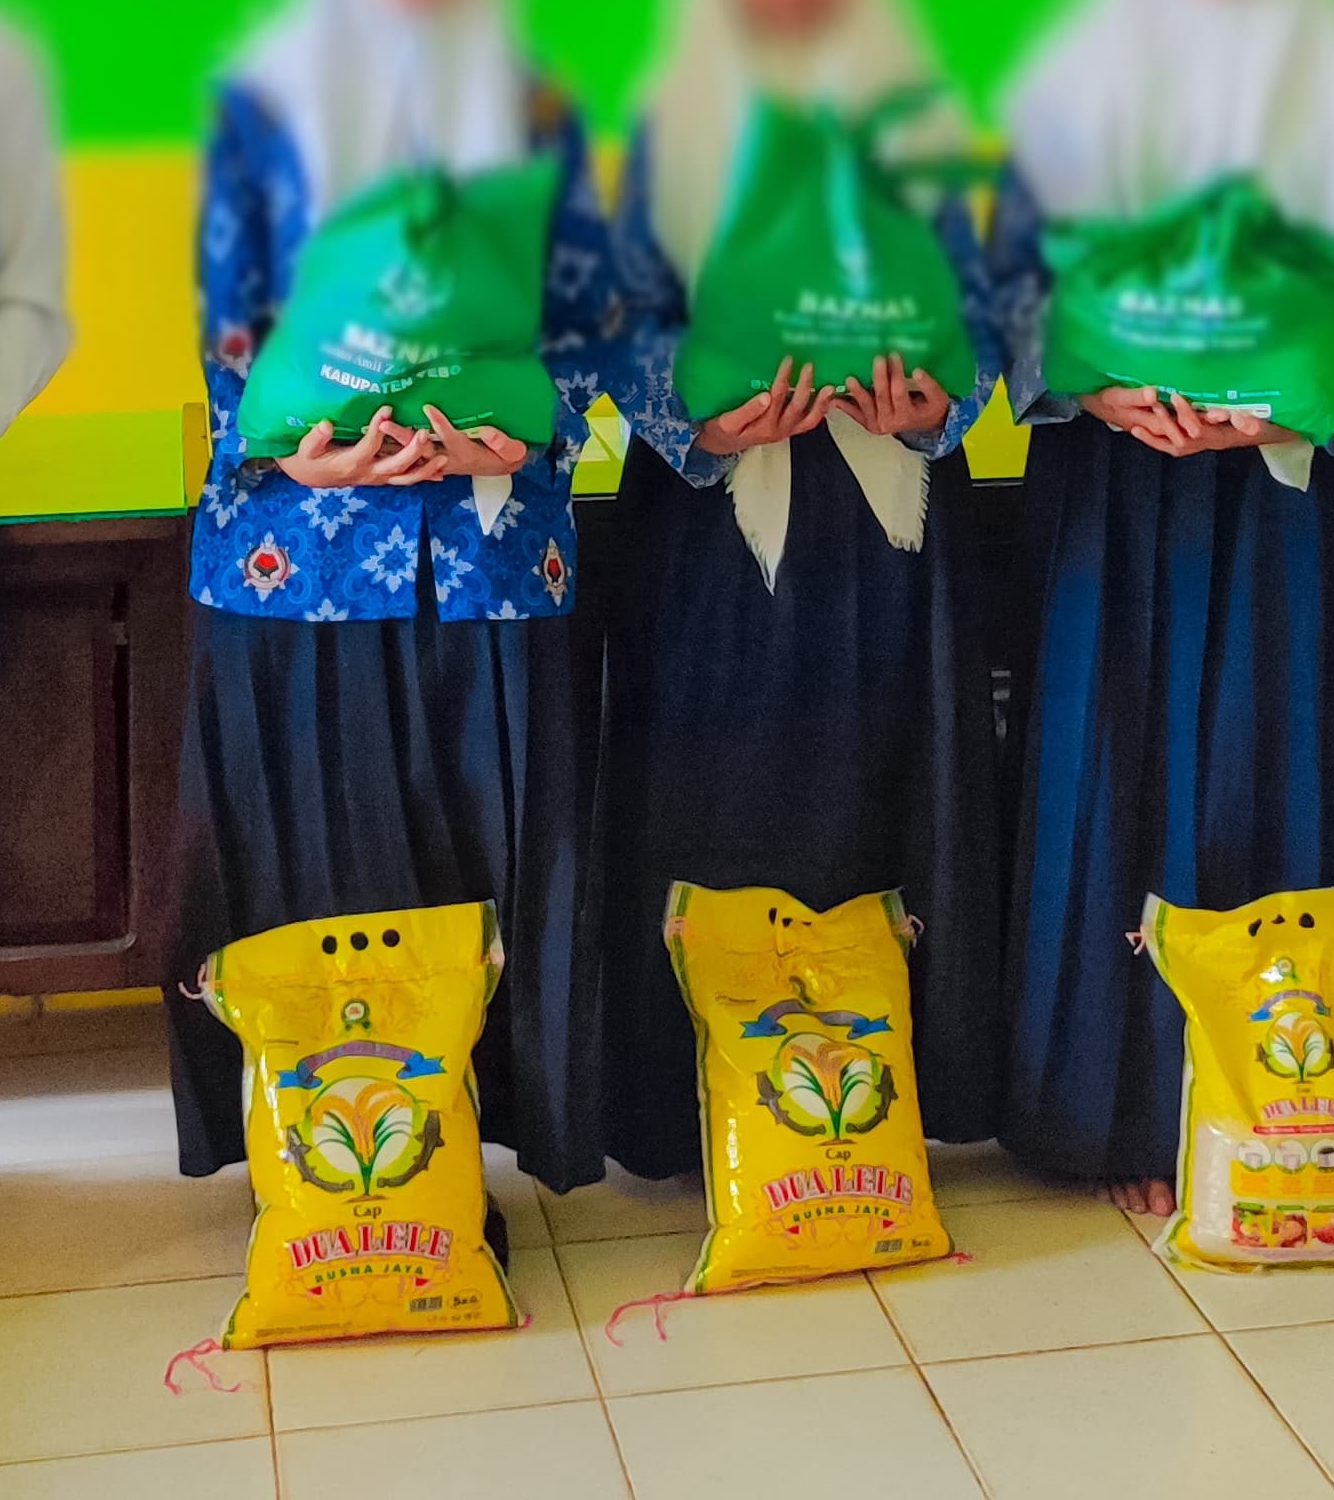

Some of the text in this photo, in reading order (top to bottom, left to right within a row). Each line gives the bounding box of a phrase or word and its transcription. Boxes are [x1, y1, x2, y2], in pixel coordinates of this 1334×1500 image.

[320, 364, 413, 395] KABUPATEN
[826, 1148, 851, 1161] Cap
[353, 1204, 382, 1219] Cap
